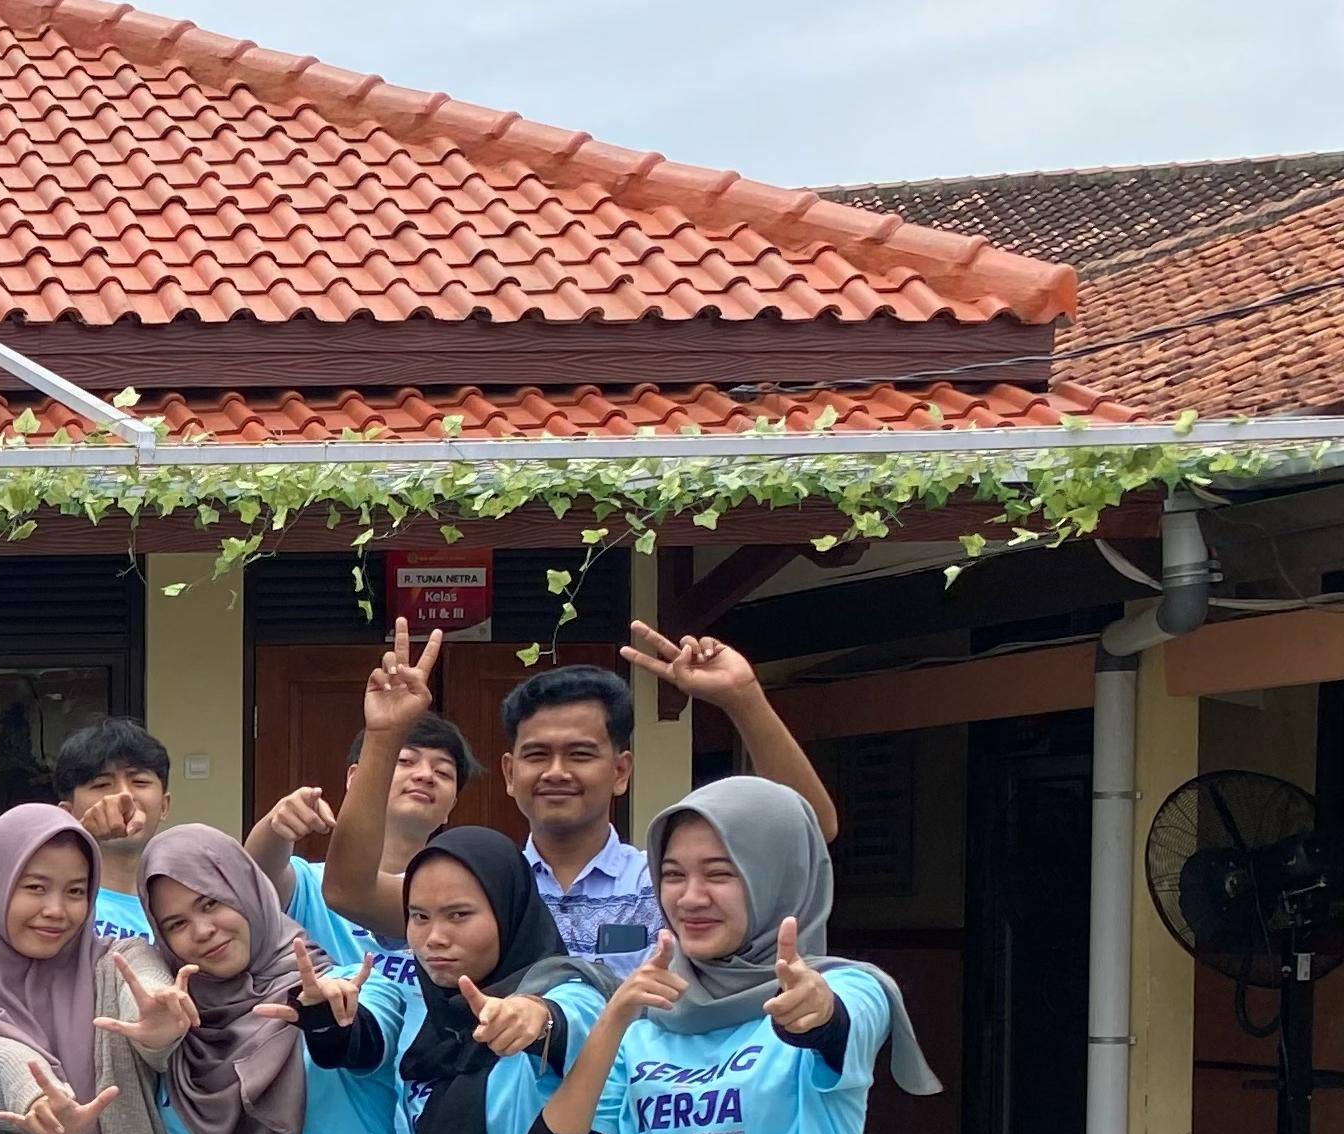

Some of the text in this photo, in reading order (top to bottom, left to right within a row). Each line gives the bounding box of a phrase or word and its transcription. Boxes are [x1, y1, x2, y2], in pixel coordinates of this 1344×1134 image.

[416, 575, 442, 583] TUNA
[445, 574, 478, 583] NETRA
[425, 591, 457, 602] Kelas
[439, 608, 449, 619] &
[453, 607, 464, 619] III
[637, 1088, 743, 1133] KERJA
